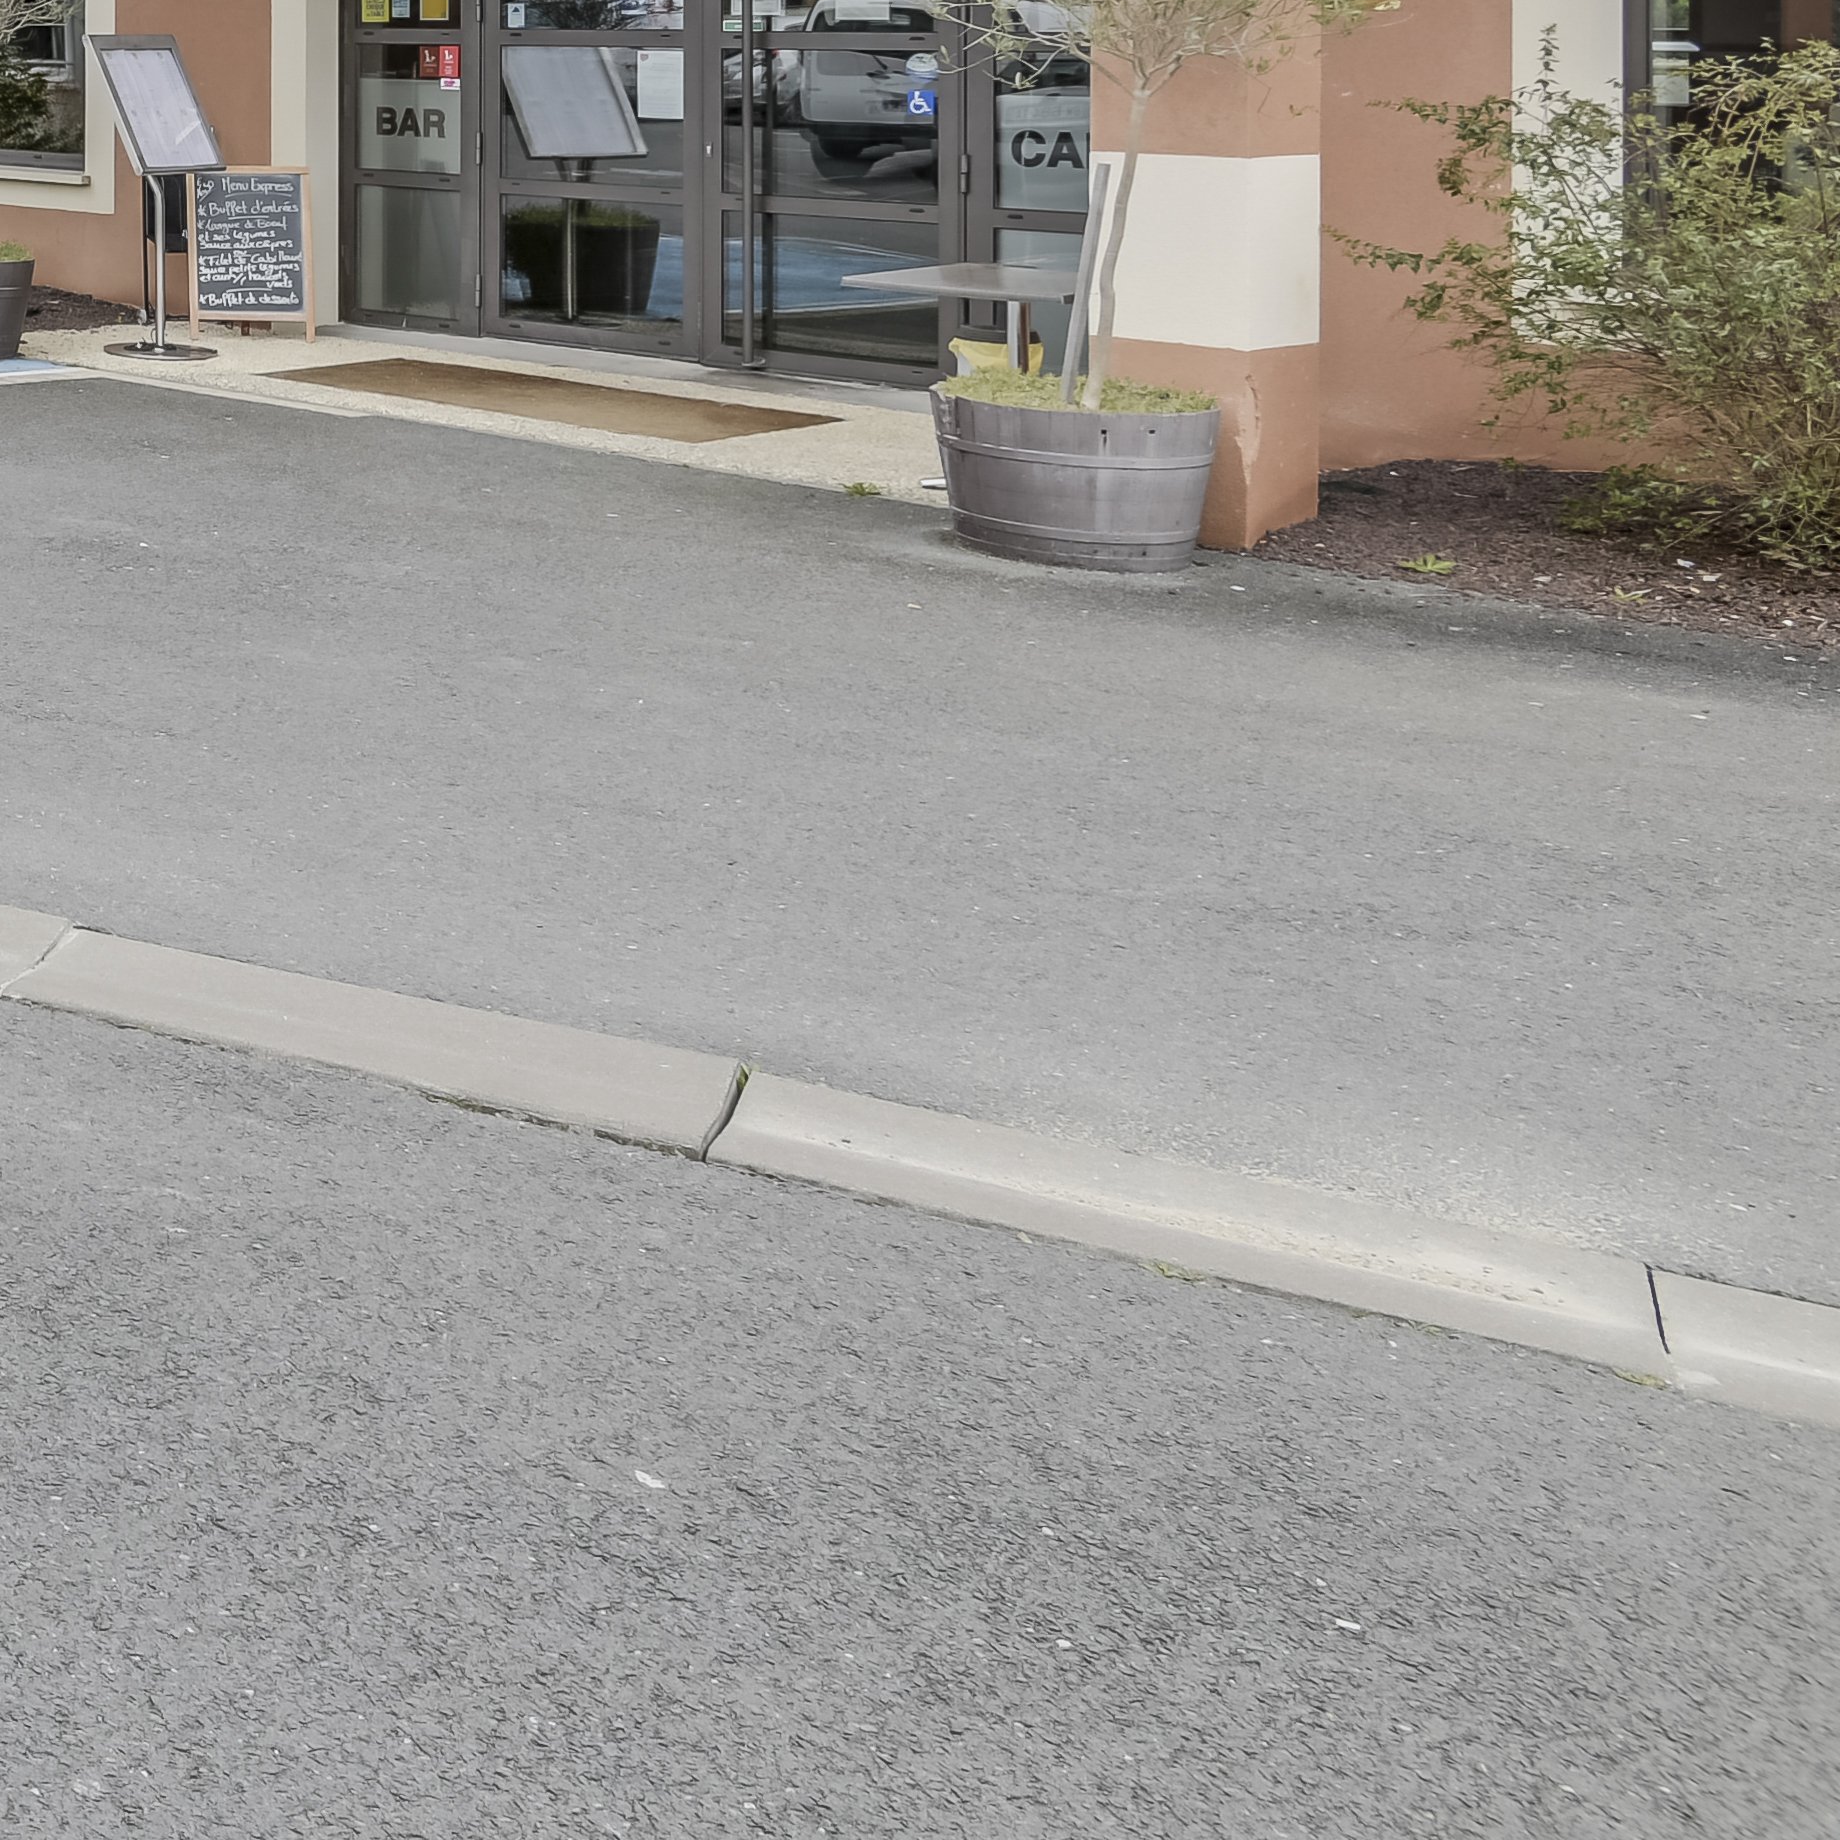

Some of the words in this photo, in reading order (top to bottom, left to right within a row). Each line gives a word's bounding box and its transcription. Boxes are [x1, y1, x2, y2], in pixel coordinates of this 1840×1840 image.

[376, 106, 446, 139] BAR
[1011, 129, 1090, 169] CA
[222, 176, 249, 194] Menu
[250, 178, 294, 195] Express
[208, 201, 247, 216] Buffet
[208, 292, 244, 307] Buffet
